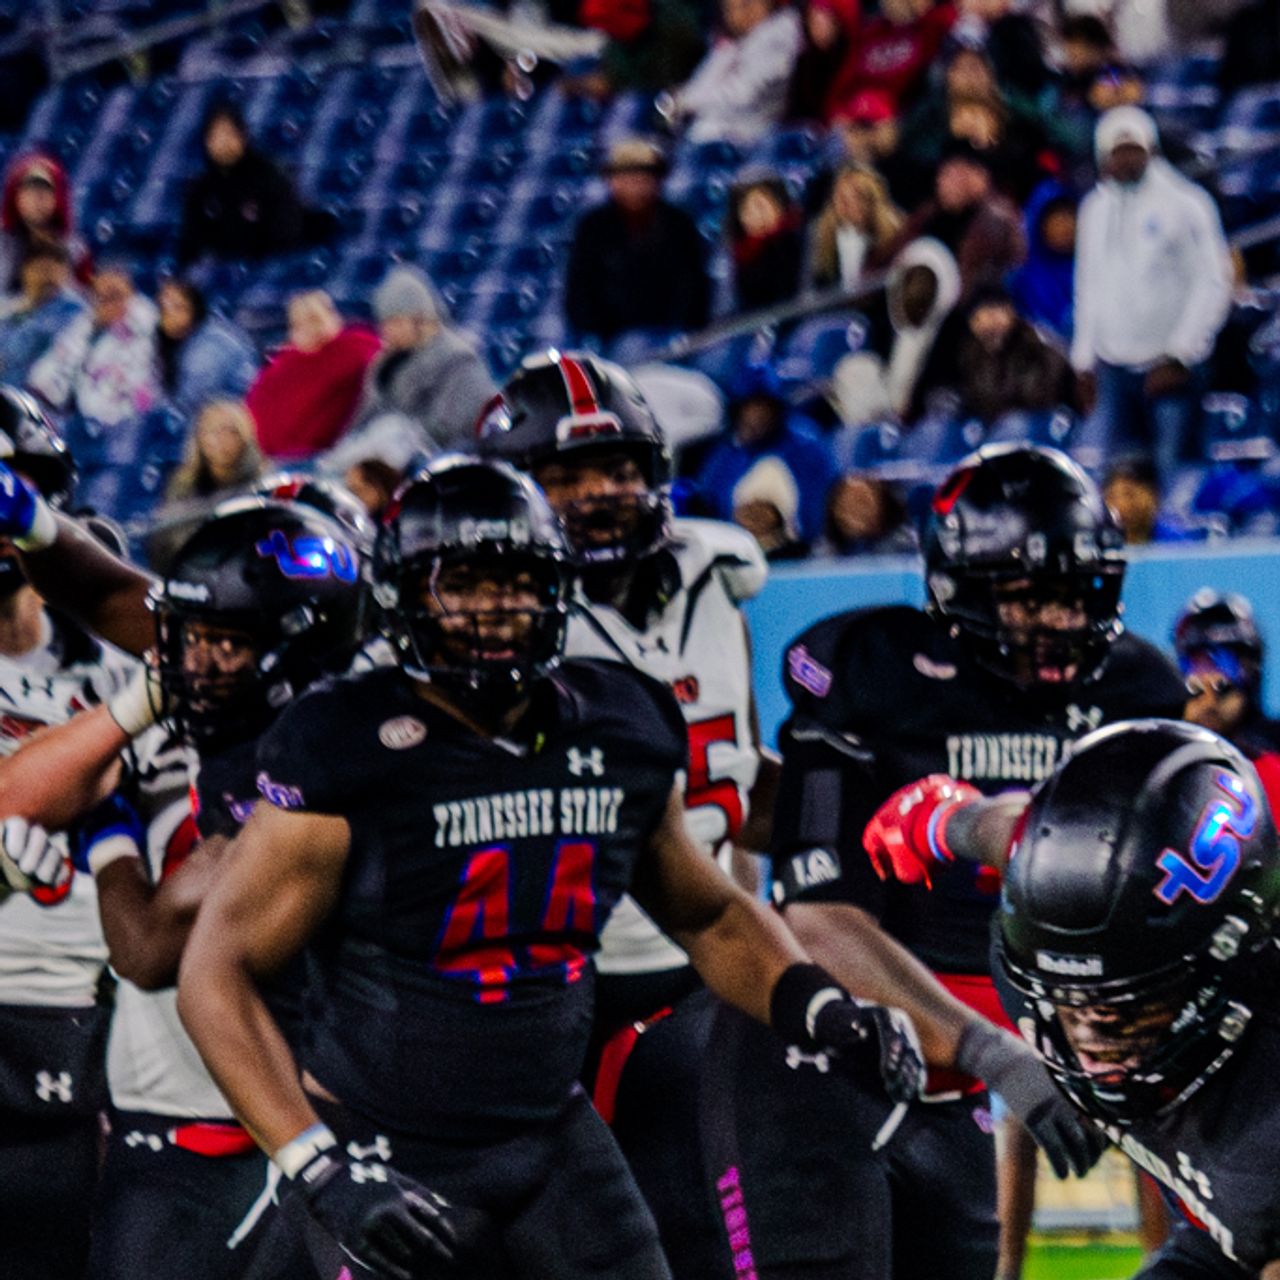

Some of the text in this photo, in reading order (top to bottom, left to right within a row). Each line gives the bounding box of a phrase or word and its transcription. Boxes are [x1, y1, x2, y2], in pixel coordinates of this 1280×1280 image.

[433, 787, 625, 848] TENNESSEE STATE
[432, 838, 596, 1004] 44
